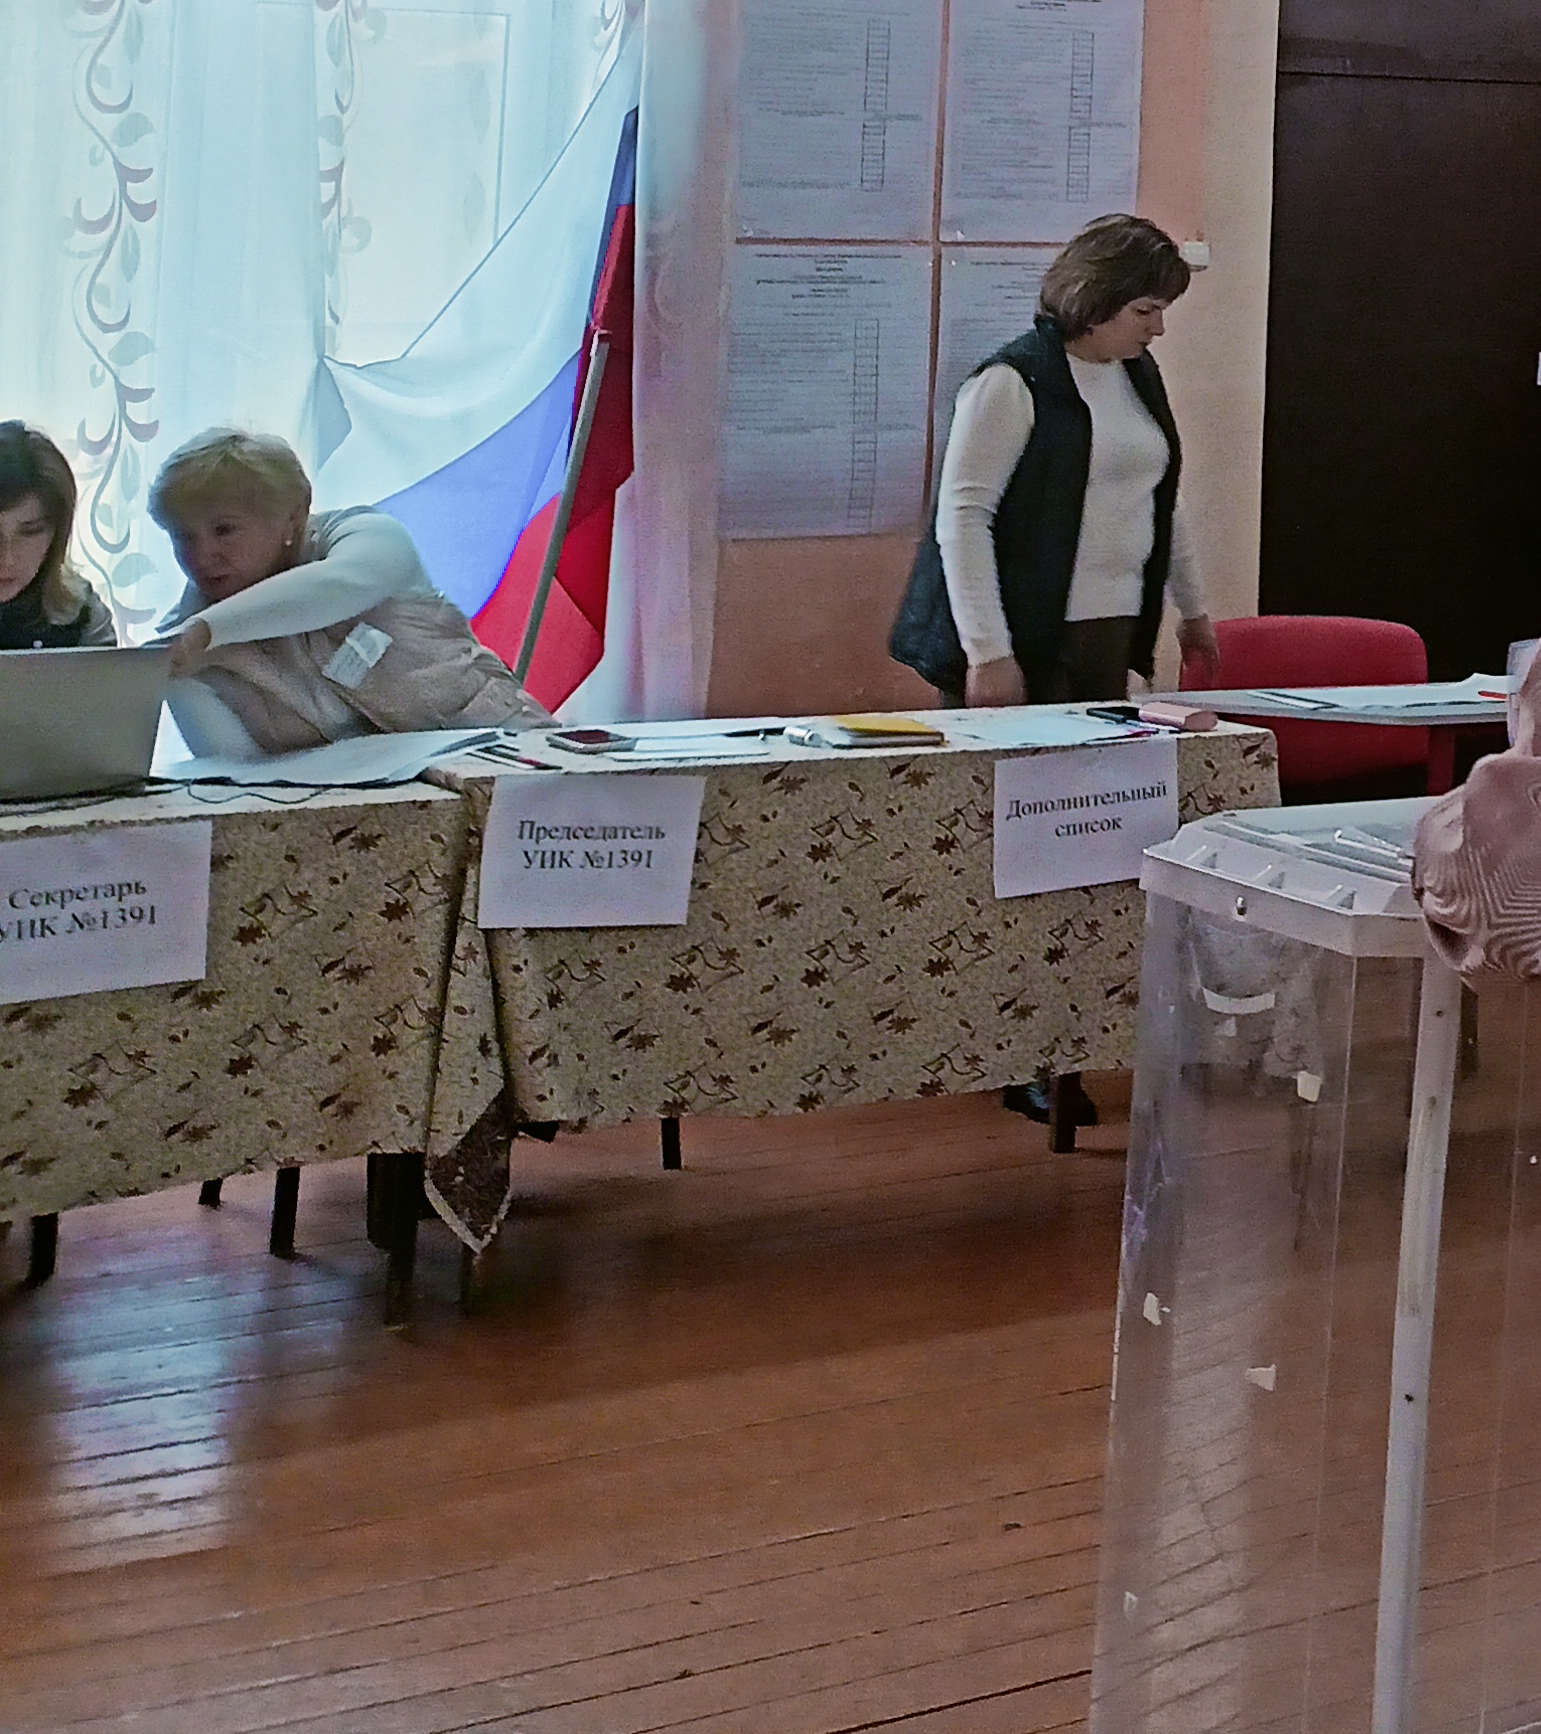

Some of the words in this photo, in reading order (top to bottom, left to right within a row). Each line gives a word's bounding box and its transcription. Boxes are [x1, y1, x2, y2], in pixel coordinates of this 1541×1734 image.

[1005, 781, 1167, 821] Дополнительный
[517, 819, 666, 845] Председатель
[1054, 817, 1123, 838] список
[579, 849, 653, 869] №1391
[8, 879, 148, 910] Секретарь
[65, 905, 156, 935] №1391
